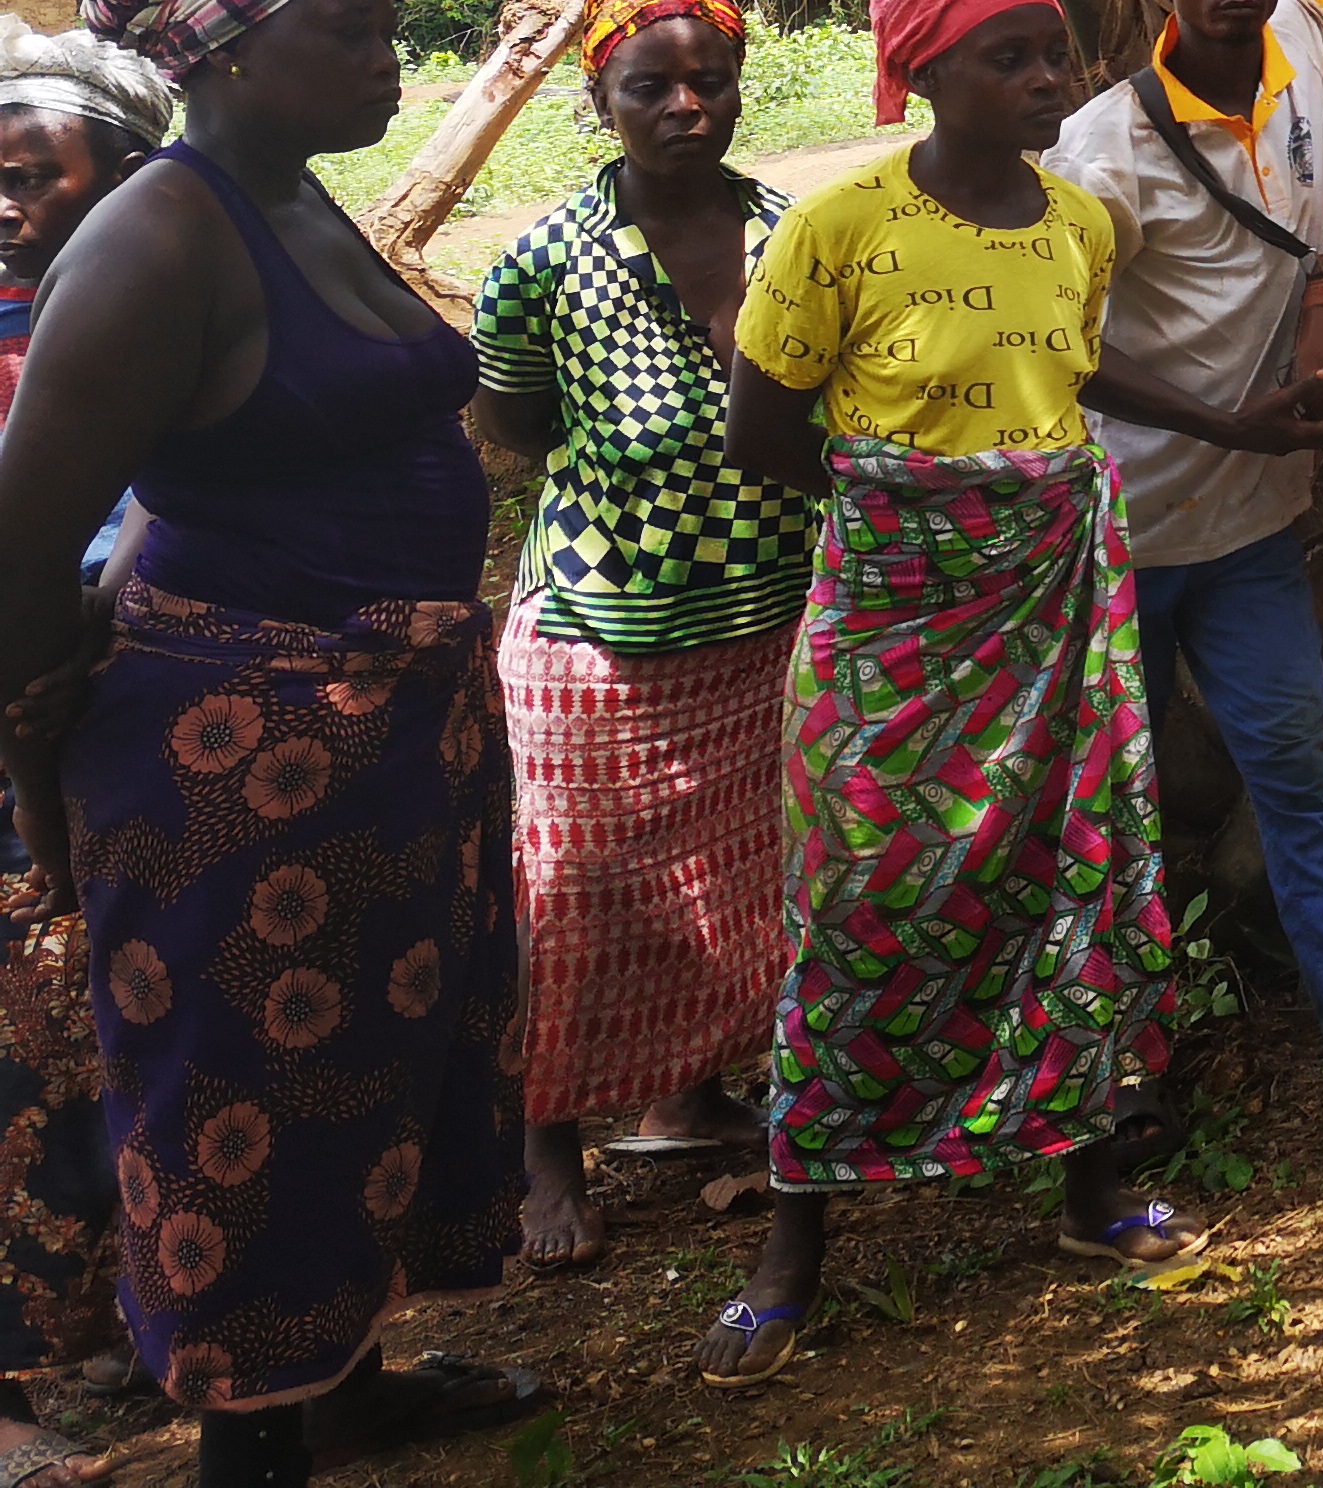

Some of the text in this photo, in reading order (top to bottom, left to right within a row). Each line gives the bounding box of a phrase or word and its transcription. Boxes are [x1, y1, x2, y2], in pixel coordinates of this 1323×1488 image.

[904, 285, 996, 311] Dior
[1055, 284, 1086, 311] ior
[992, 328, 1073, 354] Dior
[915, 382, 996, 410] Dior
